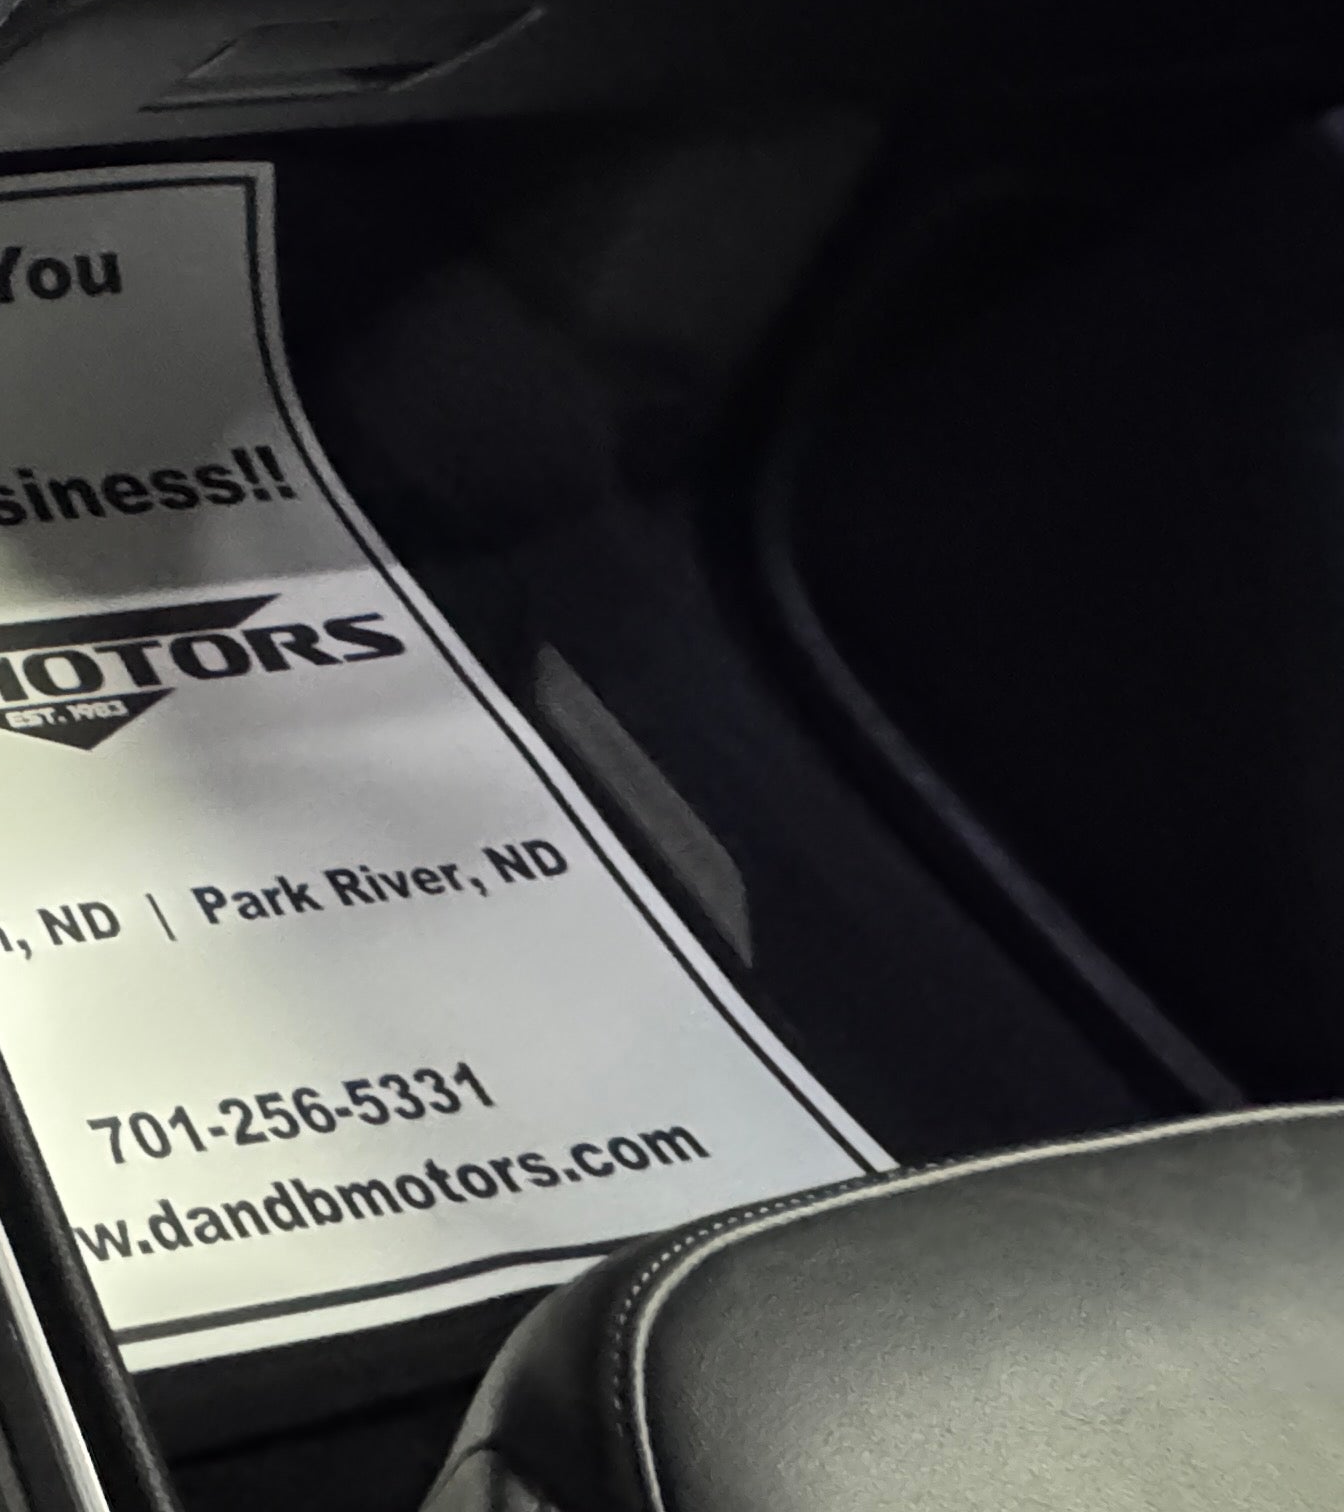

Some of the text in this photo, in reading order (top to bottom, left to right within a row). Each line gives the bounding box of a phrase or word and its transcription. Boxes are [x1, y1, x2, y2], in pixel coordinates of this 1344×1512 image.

[4, 706, 68, 729] EST.
[37, 901, 121, 946] ND
[192, 874, 325, 925] Park
[322, 861, 490, 908] River,
[482, 838, 569, 885] ND
[87, 1061, 498, 1166] 701-256-5331
